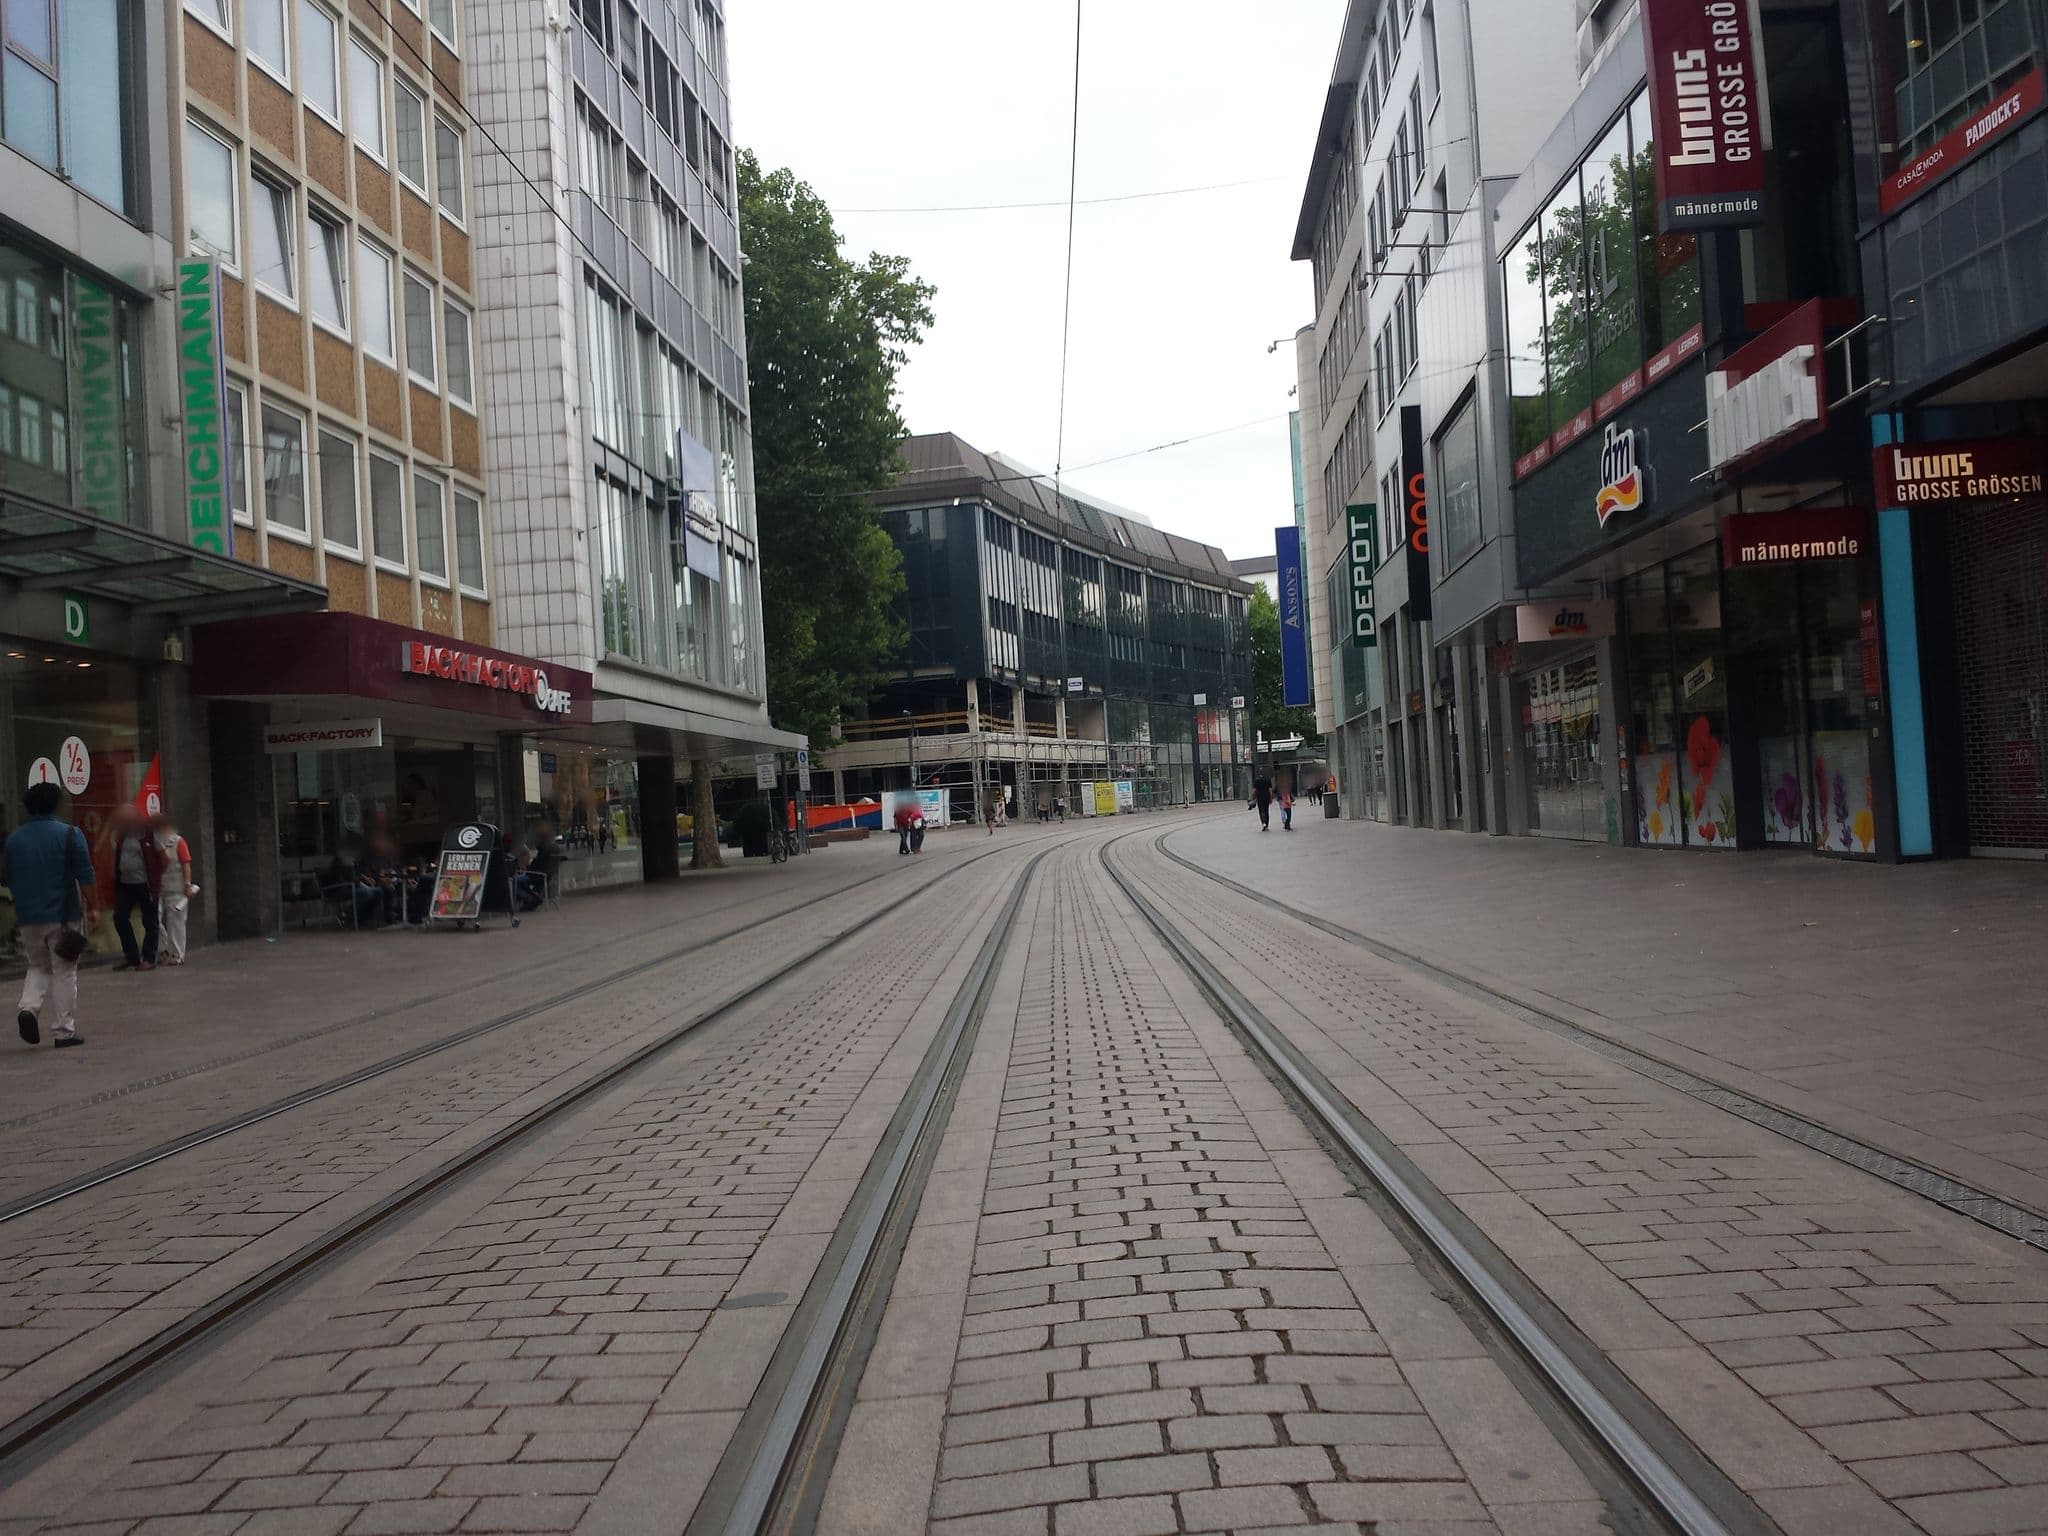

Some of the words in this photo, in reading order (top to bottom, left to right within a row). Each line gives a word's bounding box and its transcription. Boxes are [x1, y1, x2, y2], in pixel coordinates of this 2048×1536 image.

[1669, 48, 1716, 166] bruns
[1717, 62, 1751, 162] GROSSE
[1965, 92, 2021, 148] PADDOCK'S
[1675, 198, 1758, 217] männermode
[1894, 449, 1973, 481] bruns
[1897, 479, 1961, 501] GROSSE
[1967, 474, 2042, 497] GRÖSSEN
[1741, 536, 1858, 562] männermode
[1351, 515, 1375, 636] DEPOT
[65, 600, 84, 637] D
[1554, 608, 1584, 626] dm
[67, 776, 85, 786] PREIS
[447, 861, 481, 871] KENNEN
